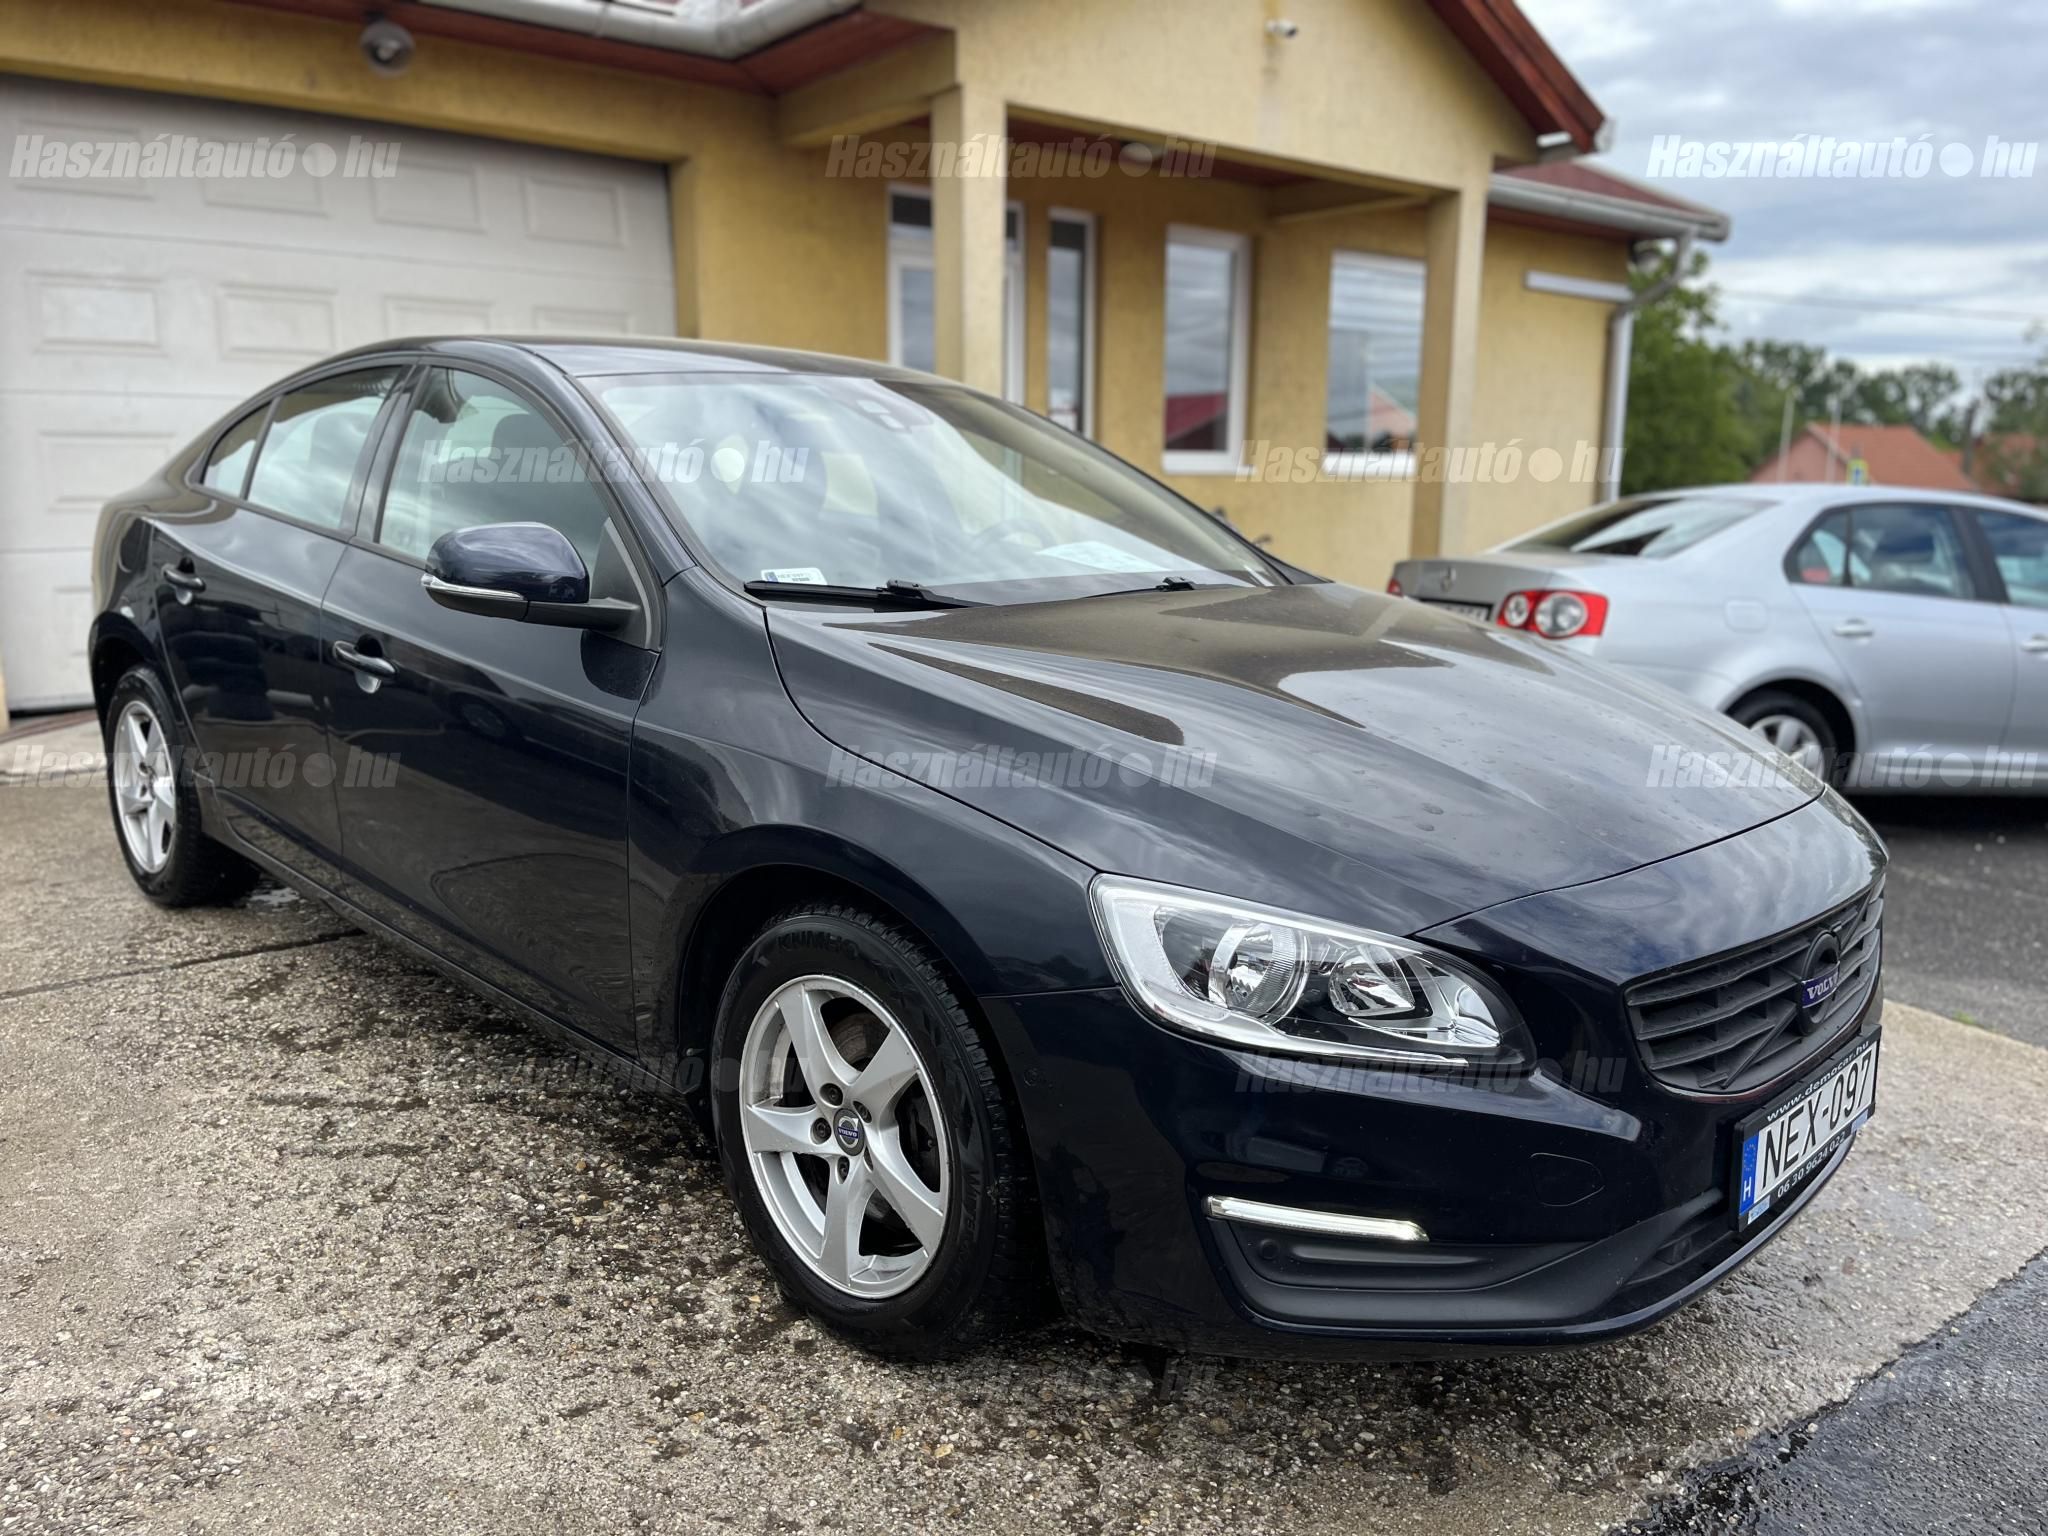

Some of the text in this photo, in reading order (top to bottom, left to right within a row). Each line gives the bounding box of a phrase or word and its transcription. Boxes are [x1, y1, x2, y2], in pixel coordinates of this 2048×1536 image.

[1761, 1048, 1872, 1190] NEX-097
[1767, 1041, 1869, 1121] www.democar.hu
[838, 1128, 858, 1138] VOLVO
